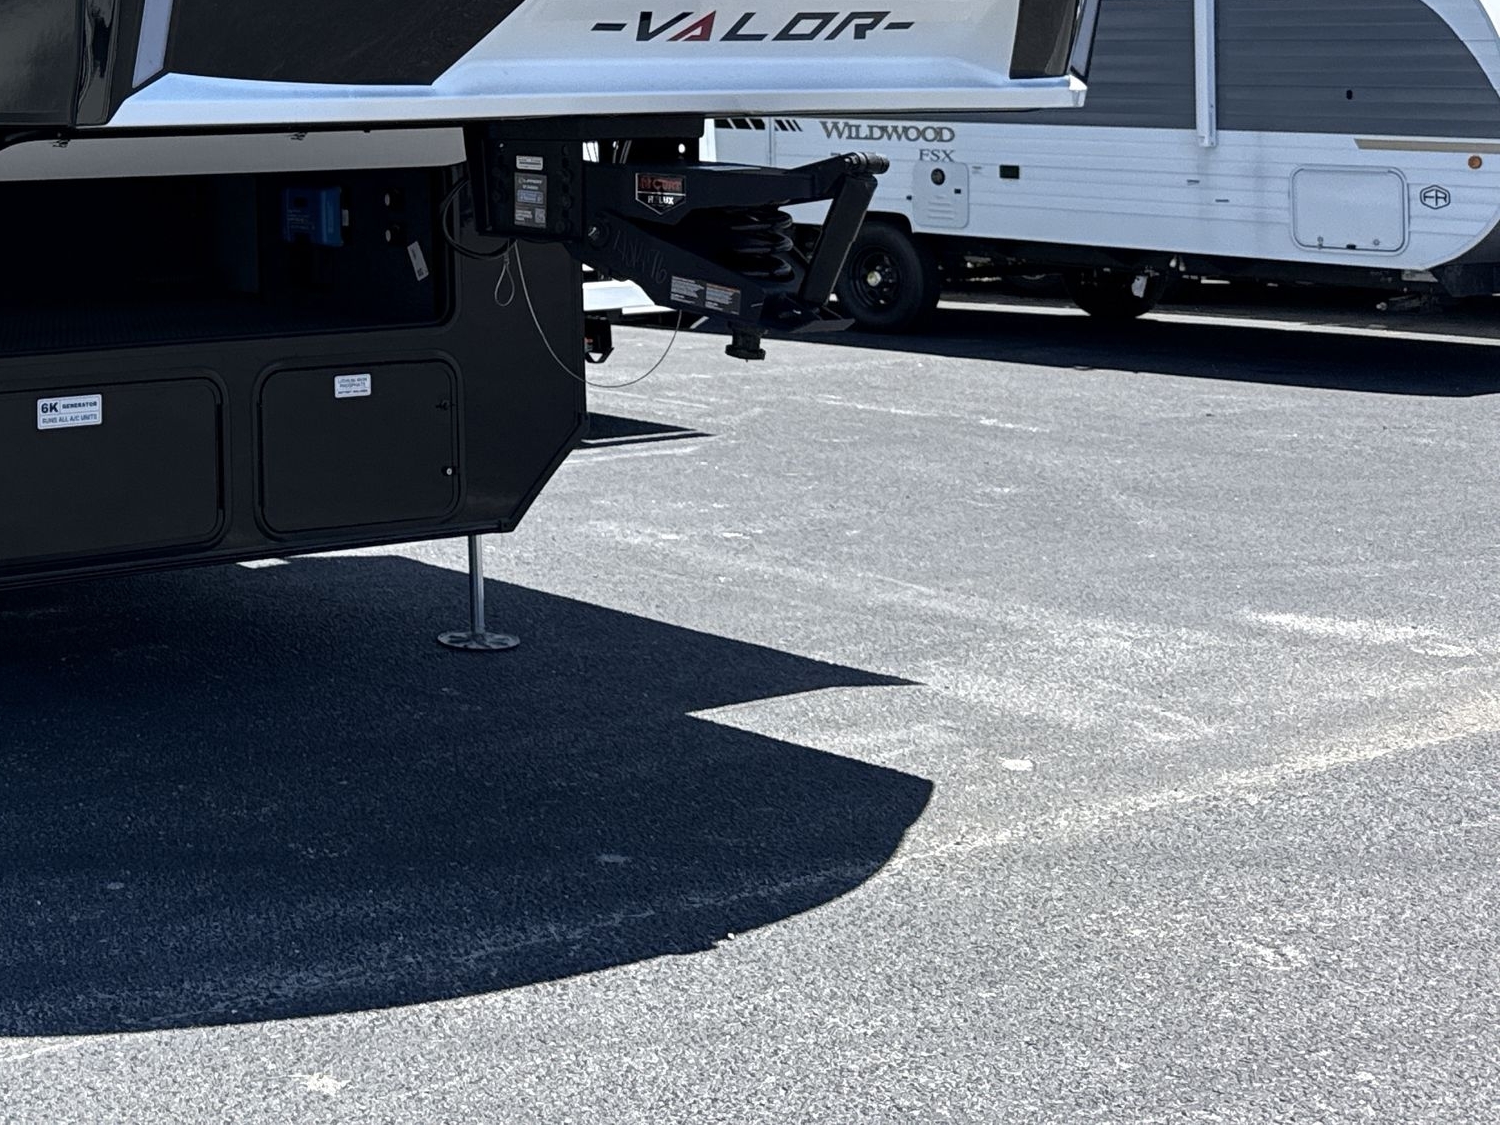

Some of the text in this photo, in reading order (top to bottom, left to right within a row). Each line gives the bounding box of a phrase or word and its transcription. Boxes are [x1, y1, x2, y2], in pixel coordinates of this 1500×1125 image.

[918, 149, 956, 163] FSX
[647, 195, 675, 205] HLUX
[41, 401, 98, 414] 6K GENERATOR
[59, 415, 69, 423] ALL
[81, 413, 98, 421] UNITS
